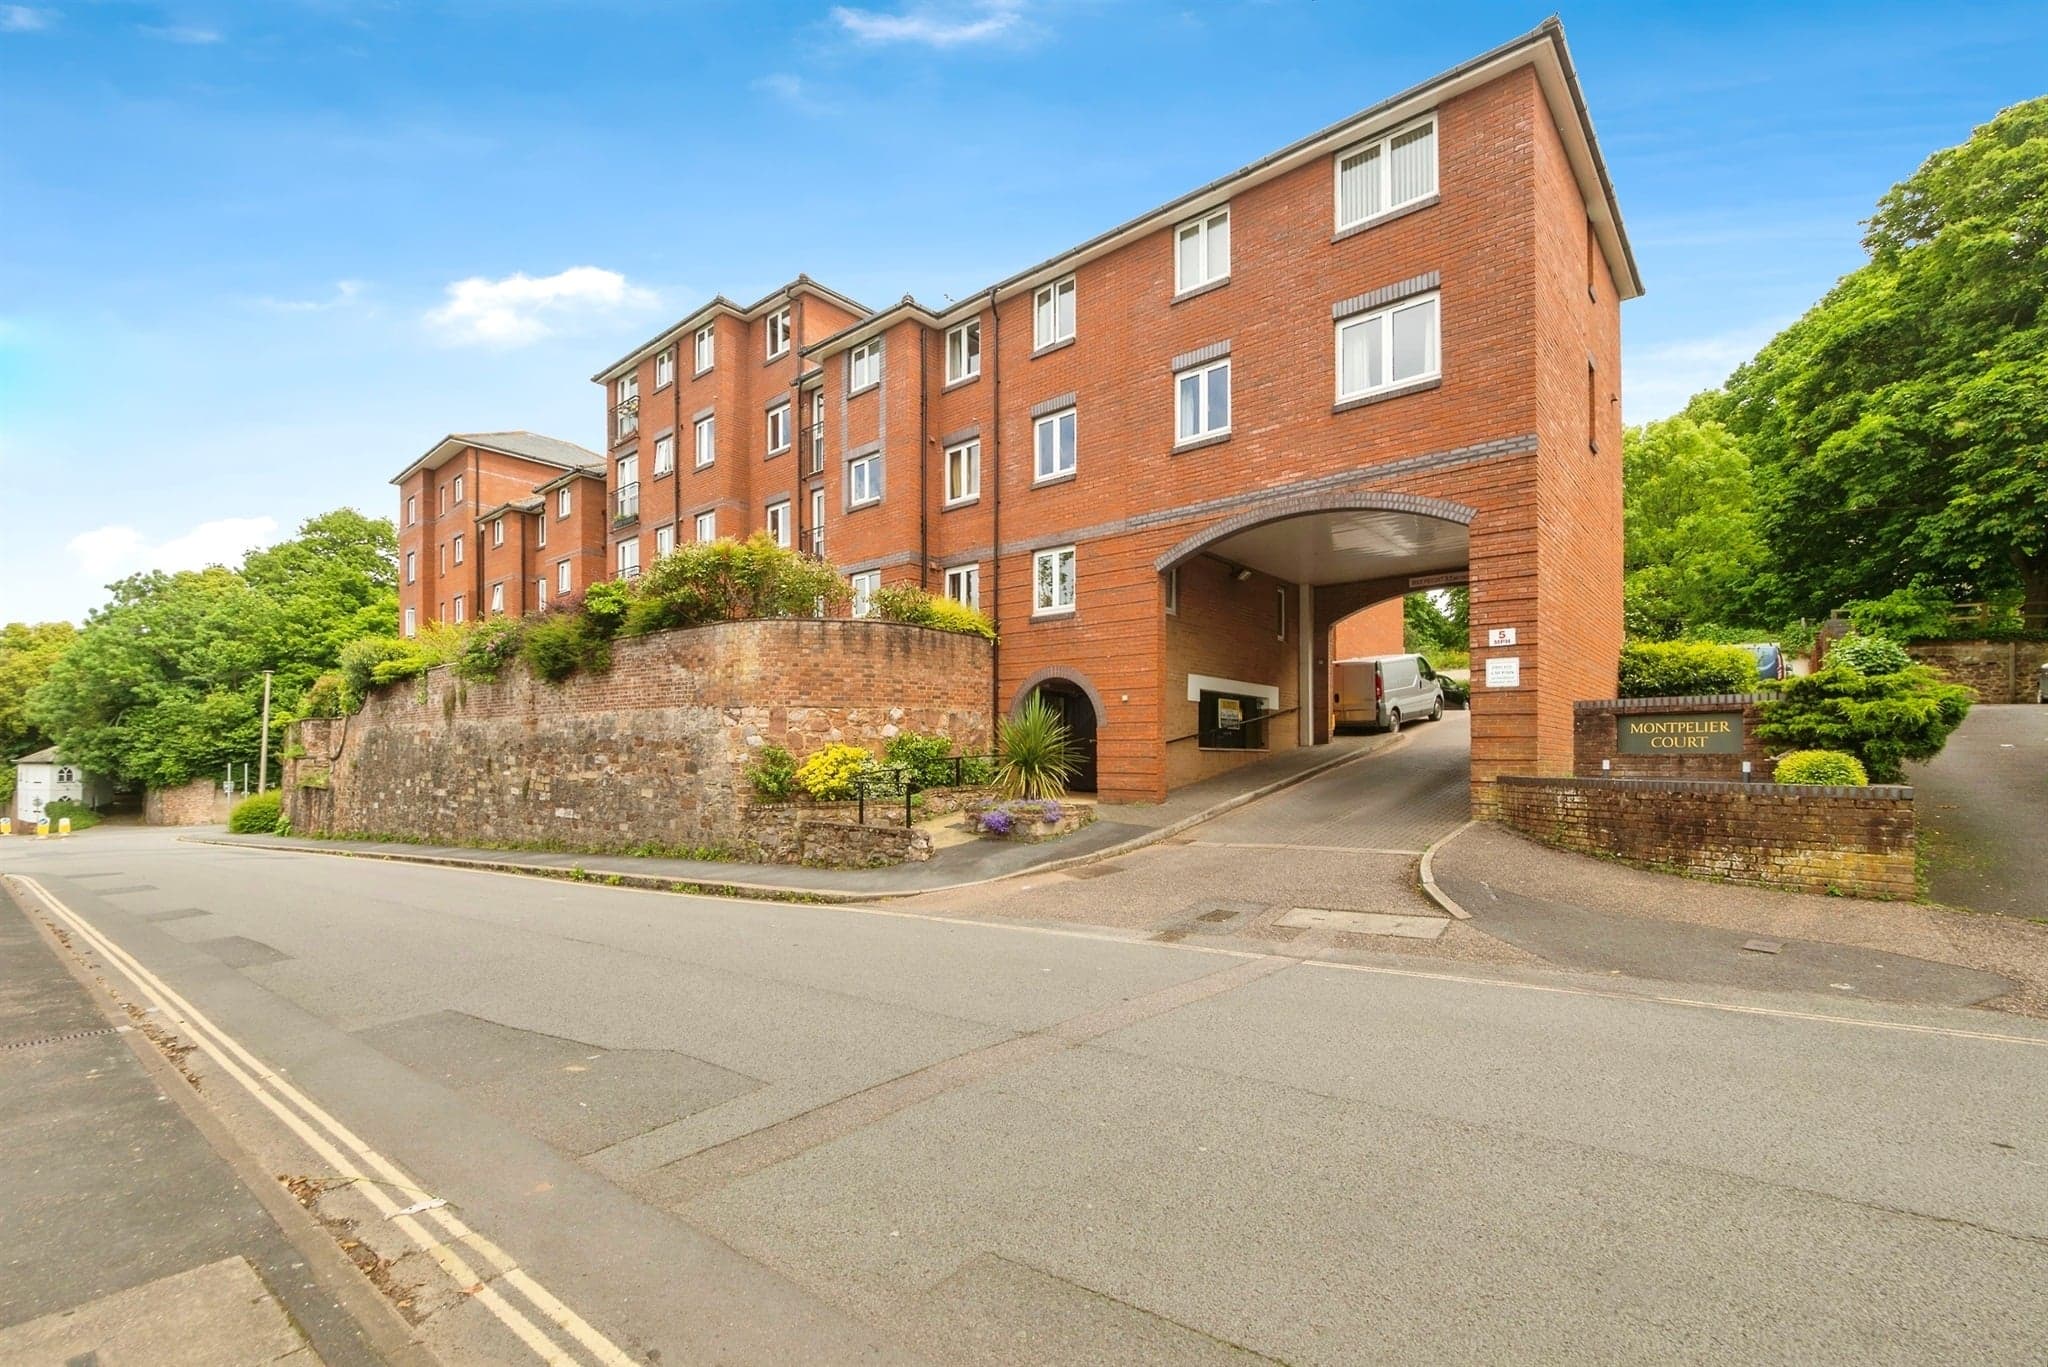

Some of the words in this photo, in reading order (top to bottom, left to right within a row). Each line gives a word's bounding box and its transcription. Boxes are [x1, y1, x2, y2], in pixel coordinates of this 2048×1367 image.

[1498, 630, 1506, 639] 5
[1630, 720, 1731, 734] MONTPELIER
[1650, 736, 1709, 748] COURT
